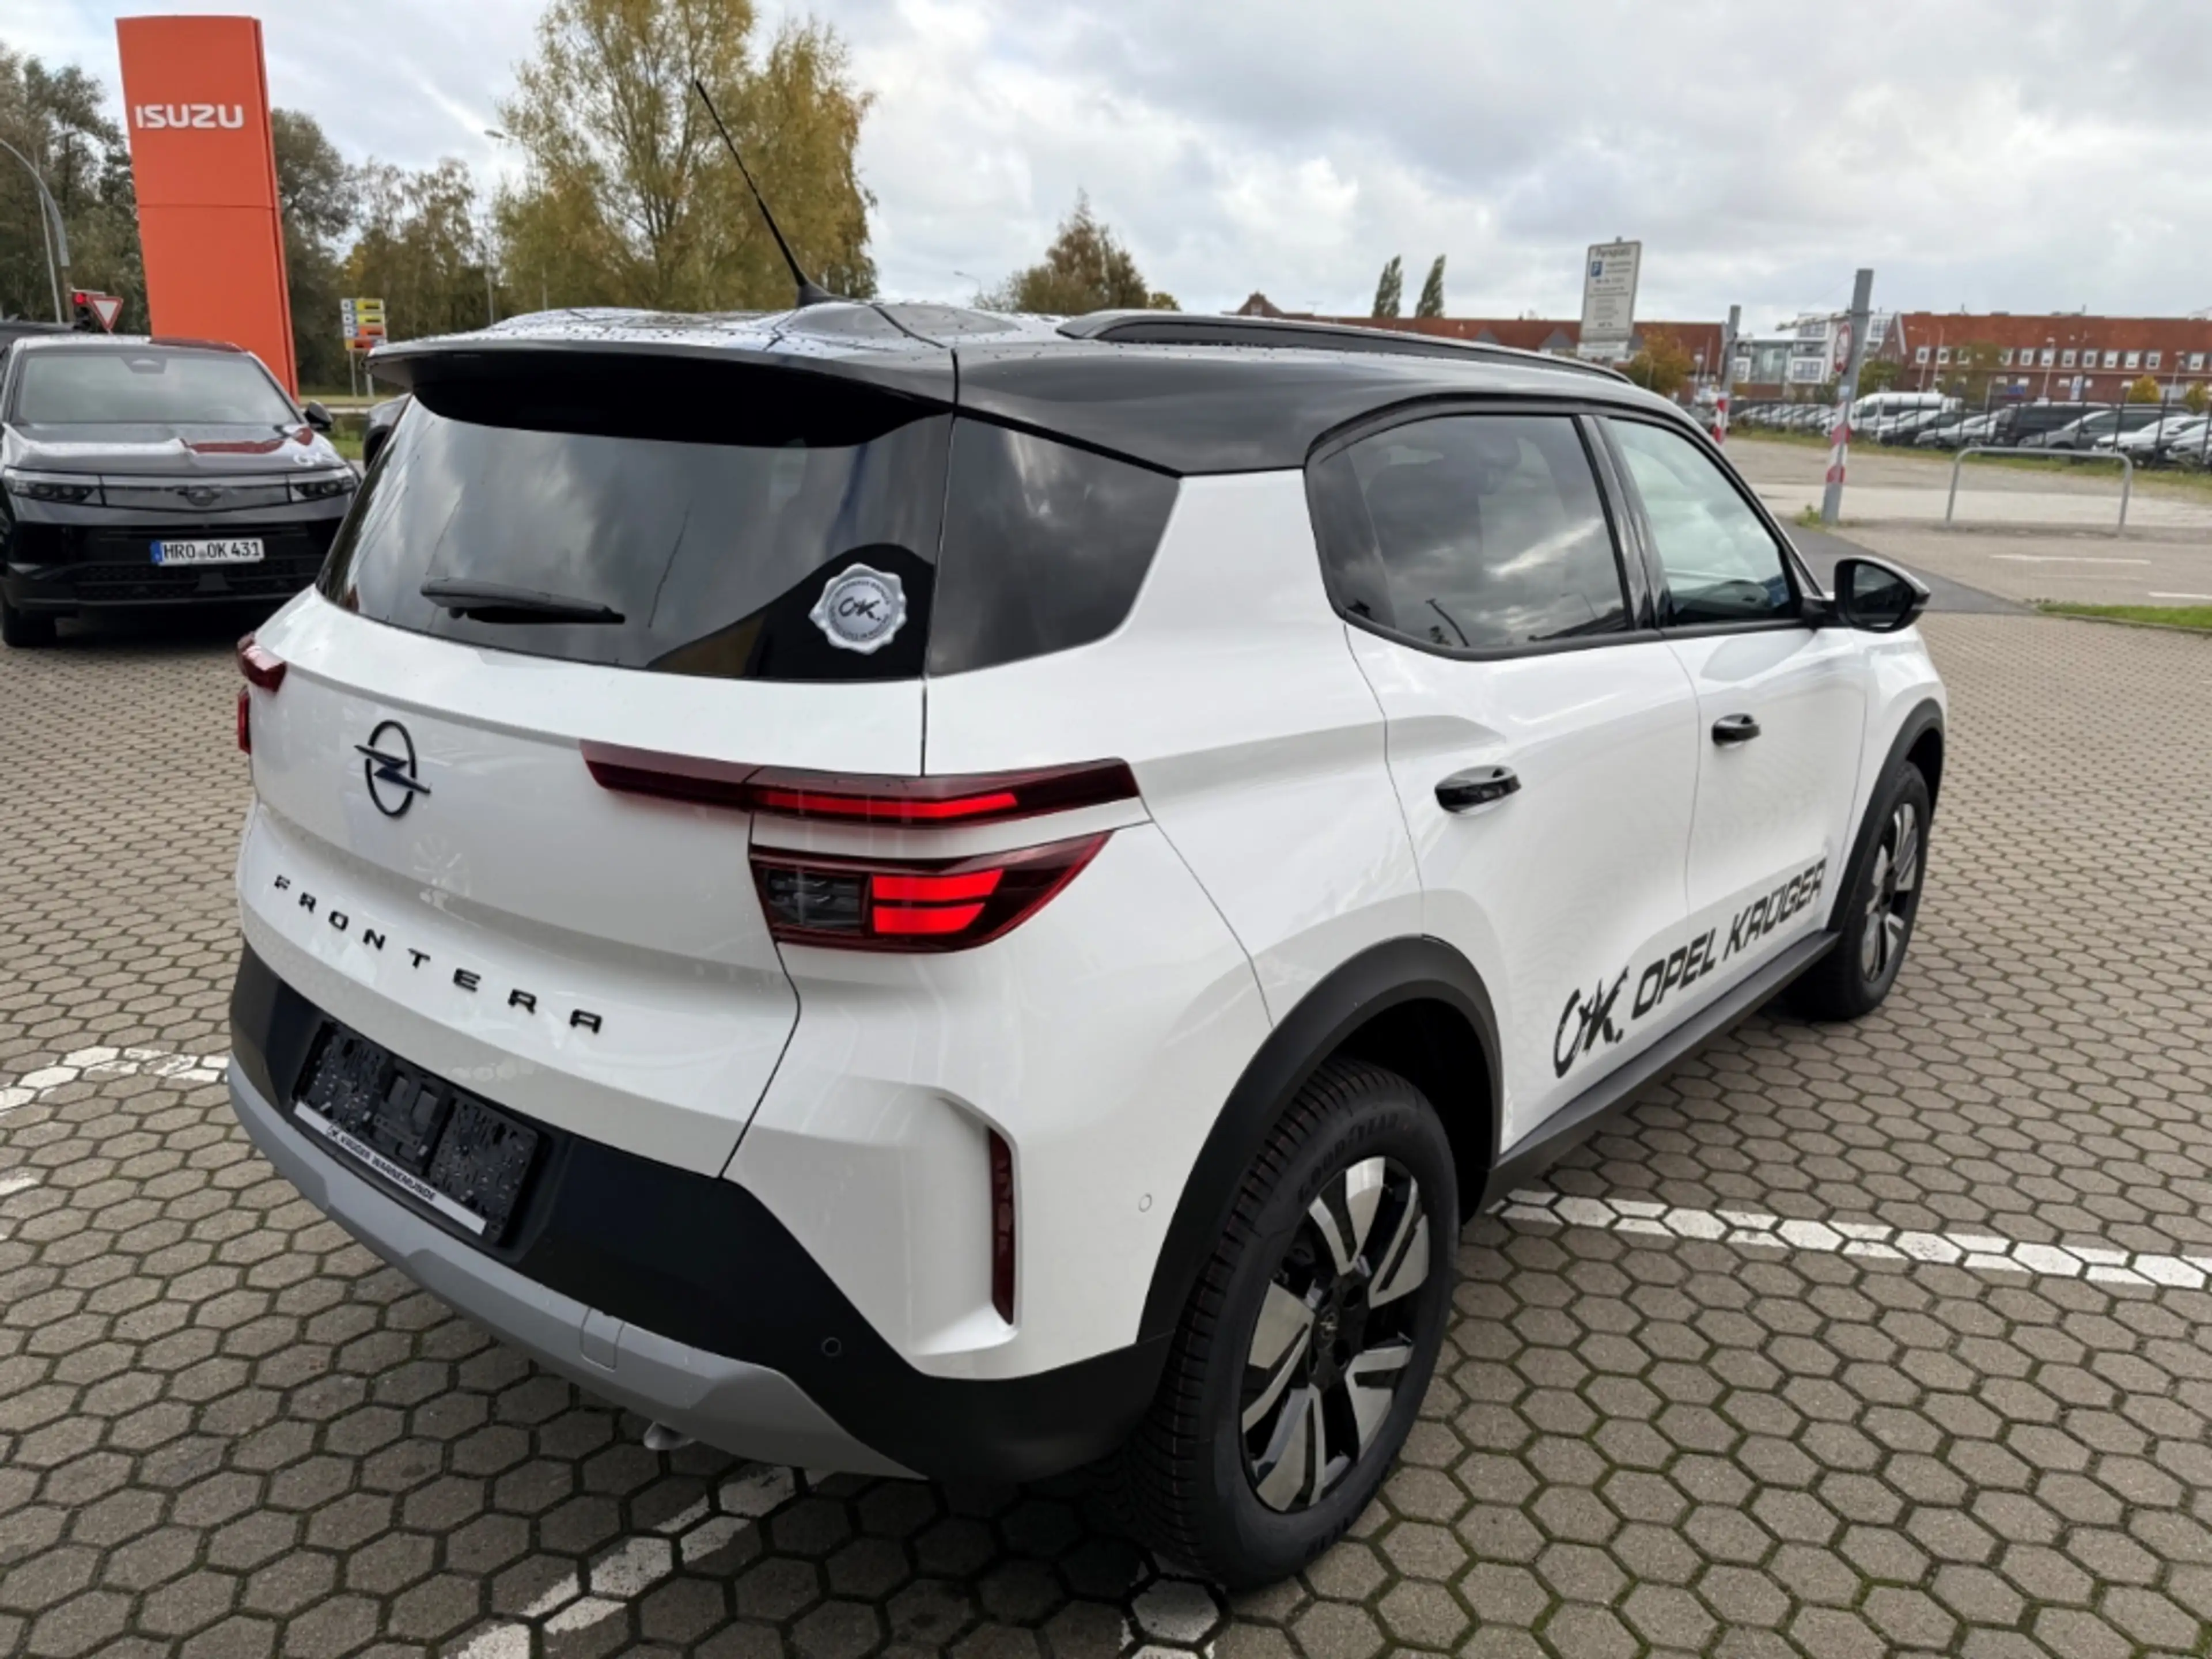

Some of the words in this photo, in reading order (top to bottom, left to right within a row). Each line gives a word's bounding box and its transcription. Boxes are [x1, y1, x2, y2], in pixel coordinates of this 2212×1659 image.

[134, 104, 244, 128] ISUZU
[164, 544, 195, 559] HRO
[207, 542, 228, 558] OK
[231, 541, 260, 557] 431
[274, 874, 603, 1035] FRONTERA
[1630, 927, 1717, 1021] OPEL
